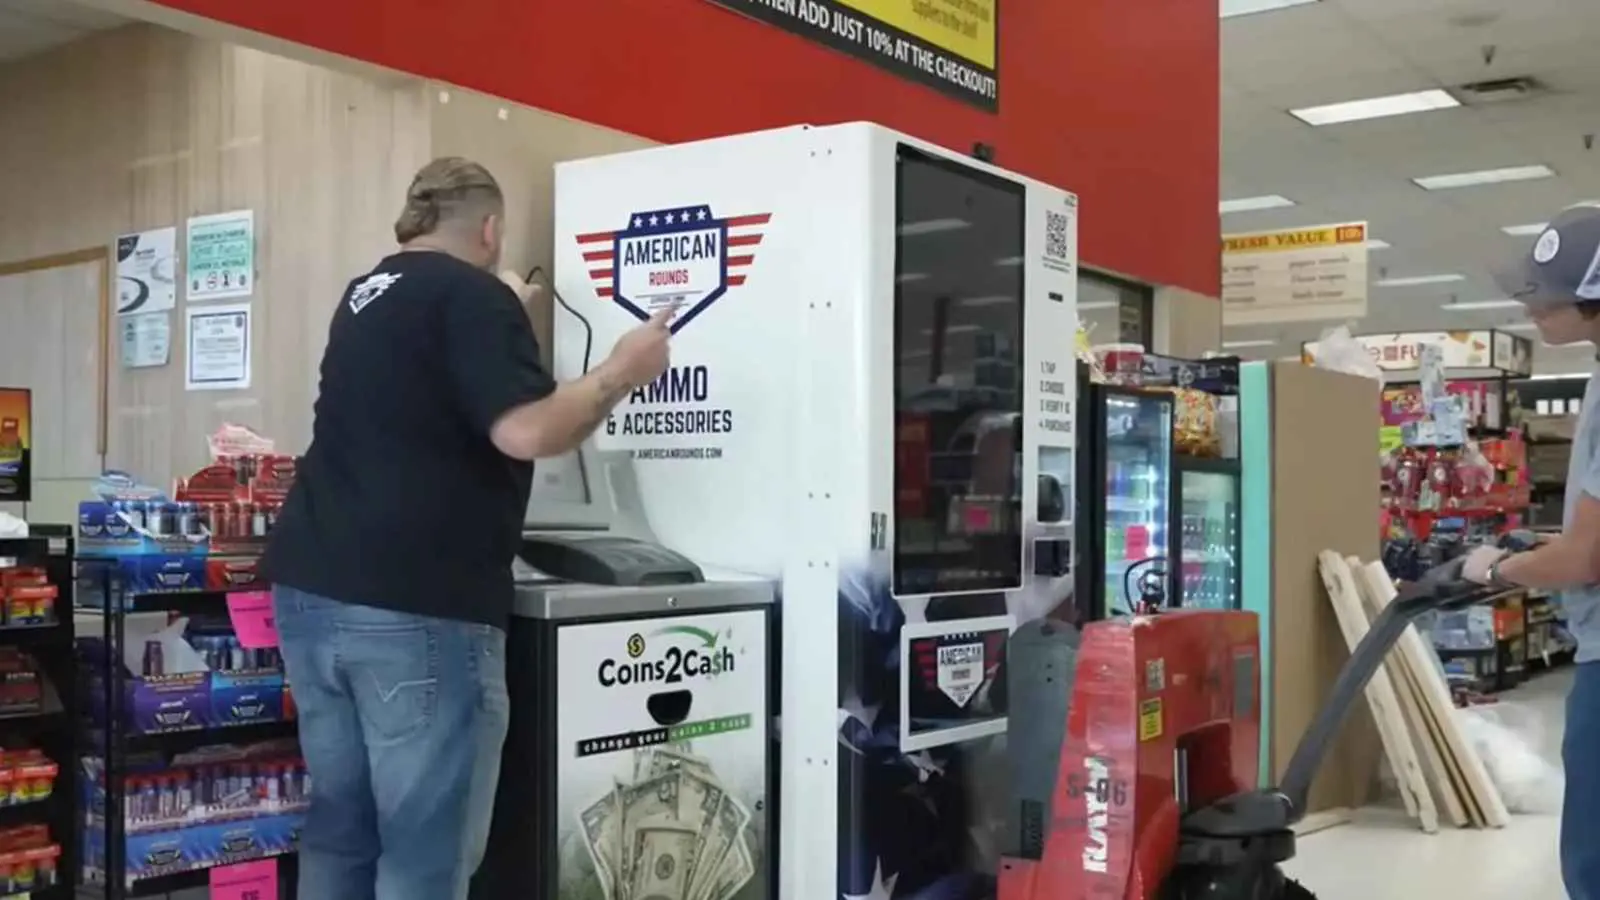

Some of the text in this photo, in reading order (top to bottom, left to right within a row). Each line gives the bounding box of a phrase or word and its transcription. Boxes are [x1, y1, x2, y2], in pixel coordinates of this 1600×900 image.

[798, 0, 830, 28] ADD
[832, 11, 864, 43] JUST
[866, 27, 893, 56] 10%
[895, 38, 910, 63] AT
[910, 45, 935, 74] THE
[936, 55, 996, 99] CHECKOUT!
[623, 232, 716, 266] AMERICAN
[1275, 230, 1329, 245] VALUE
[649, 269, 689, 286] ROUNDS
[606, 410, 732, 435] & ACCESSORIES
[584, 738, 631, 753] change
[638, 730, 666, 746] your
